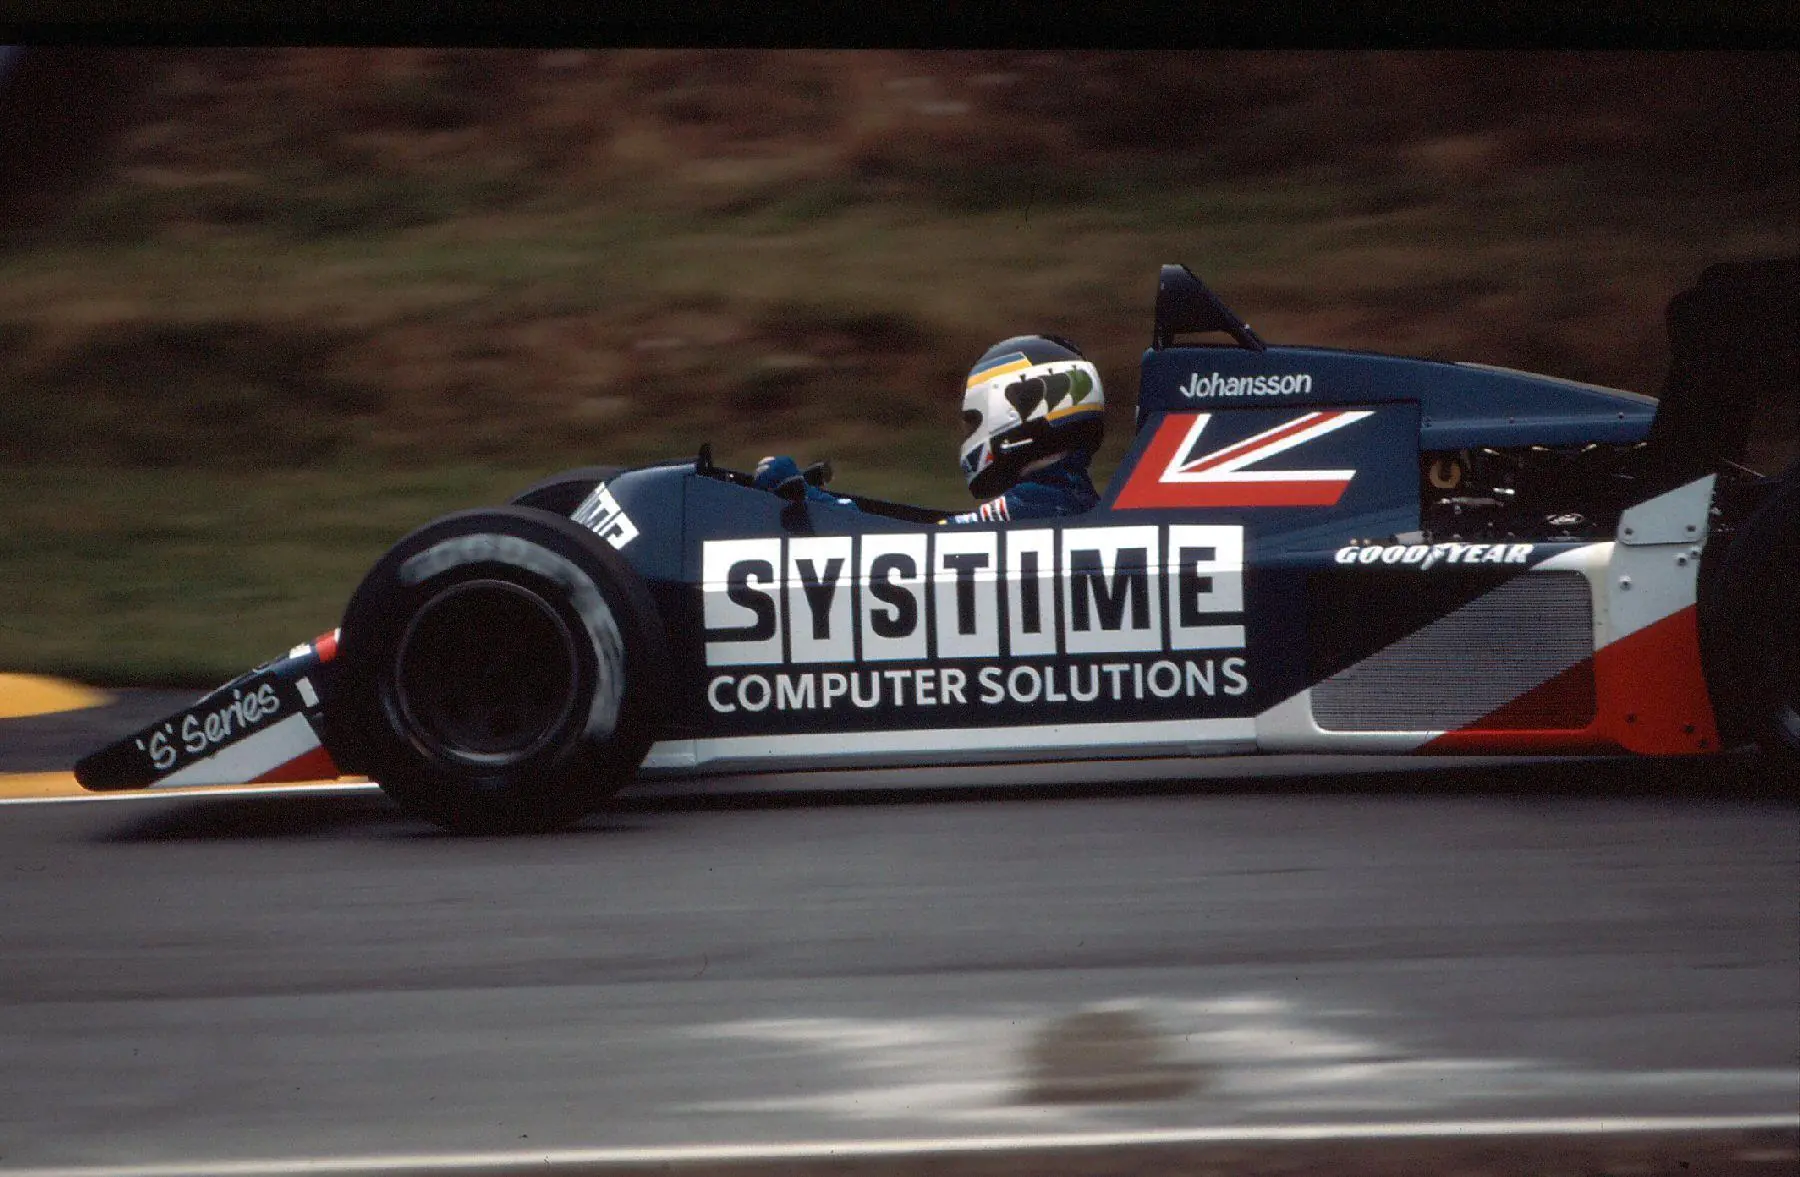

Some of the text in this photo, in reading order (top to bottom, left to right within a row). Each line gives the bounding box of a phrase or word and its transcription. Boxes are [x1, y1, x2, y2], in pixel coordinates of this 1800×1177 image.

[1179, 372, 1312, 398] Johansson
[1334, 542, 1534, 571] GOODYEAR
[704, 545, 1245, 643] SYSTIME
[707, 657, 1249, 714] COMPUTER SOLUTIONS
[181, 683, 280, 753] Series
